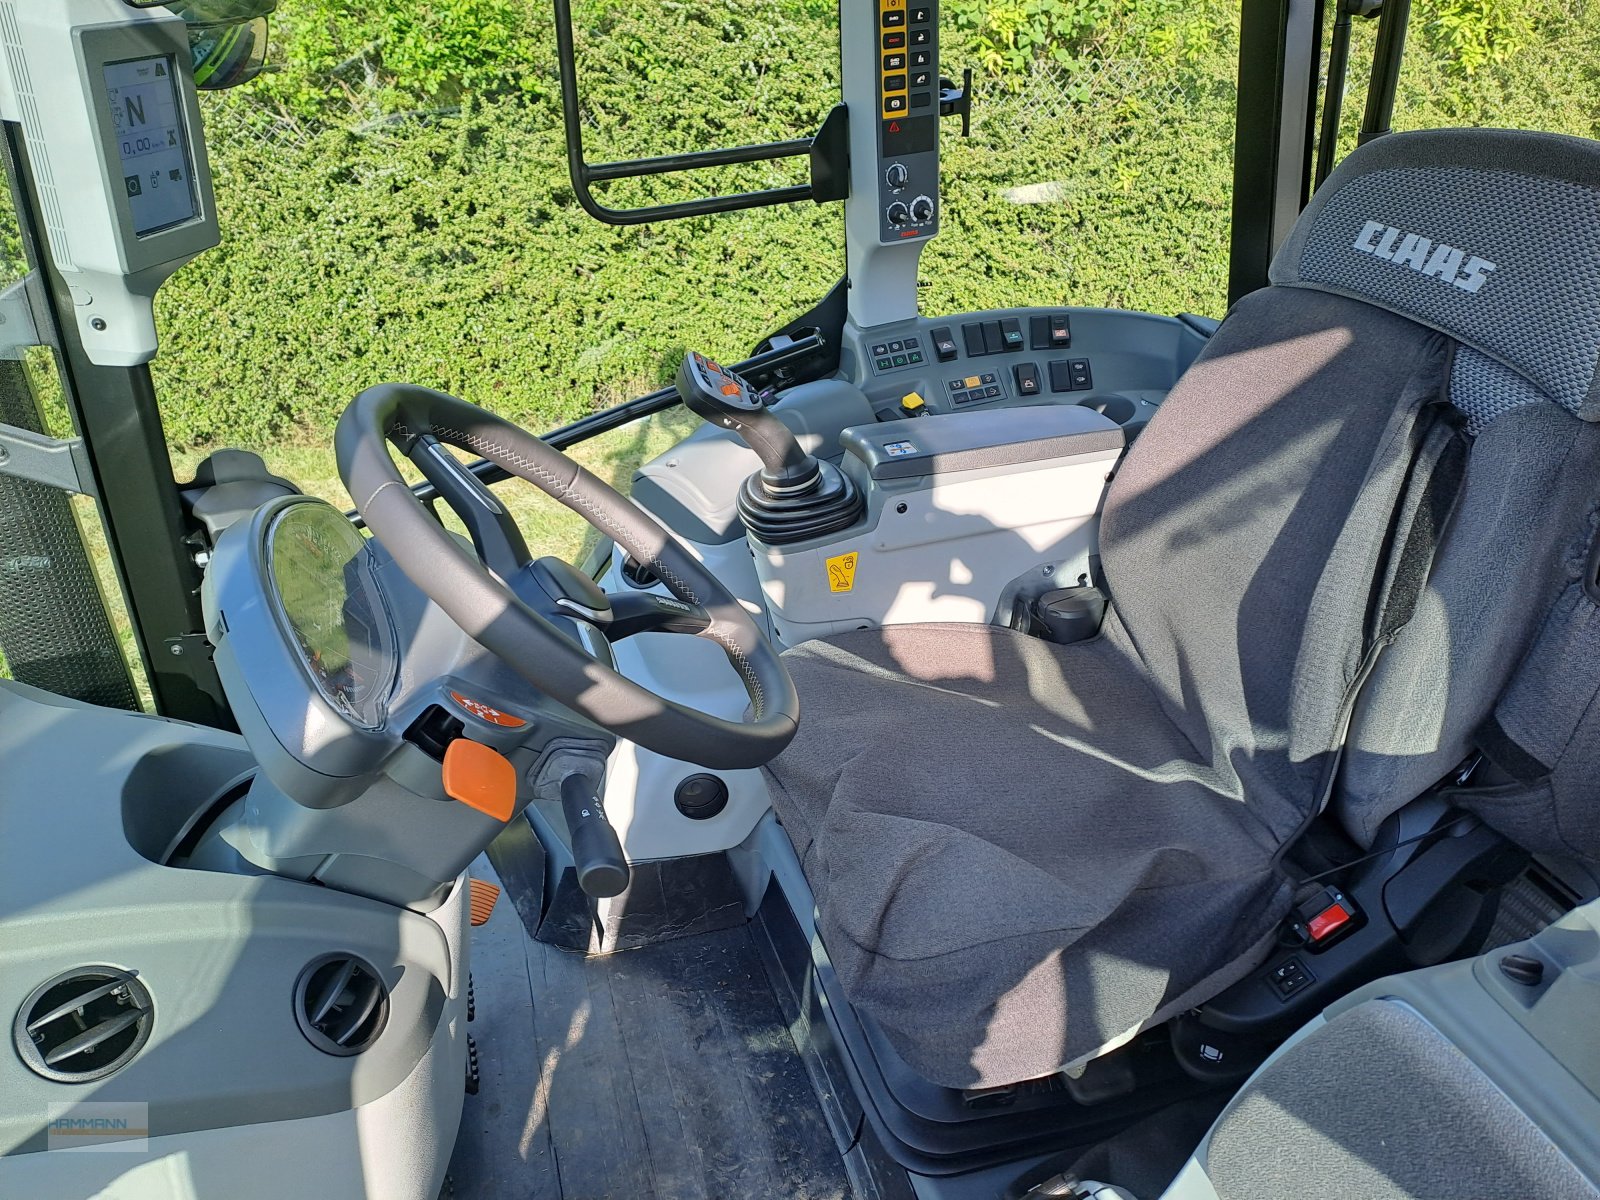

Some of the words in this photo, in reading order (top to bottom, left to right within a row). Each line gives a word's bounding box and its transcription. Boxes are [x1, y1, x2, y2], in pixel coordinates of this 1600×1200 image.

[125, 95, 146, 127] N
[123, 137, 150, 155] 0,00
[1353, 220, 1496, 293] CLAAS
